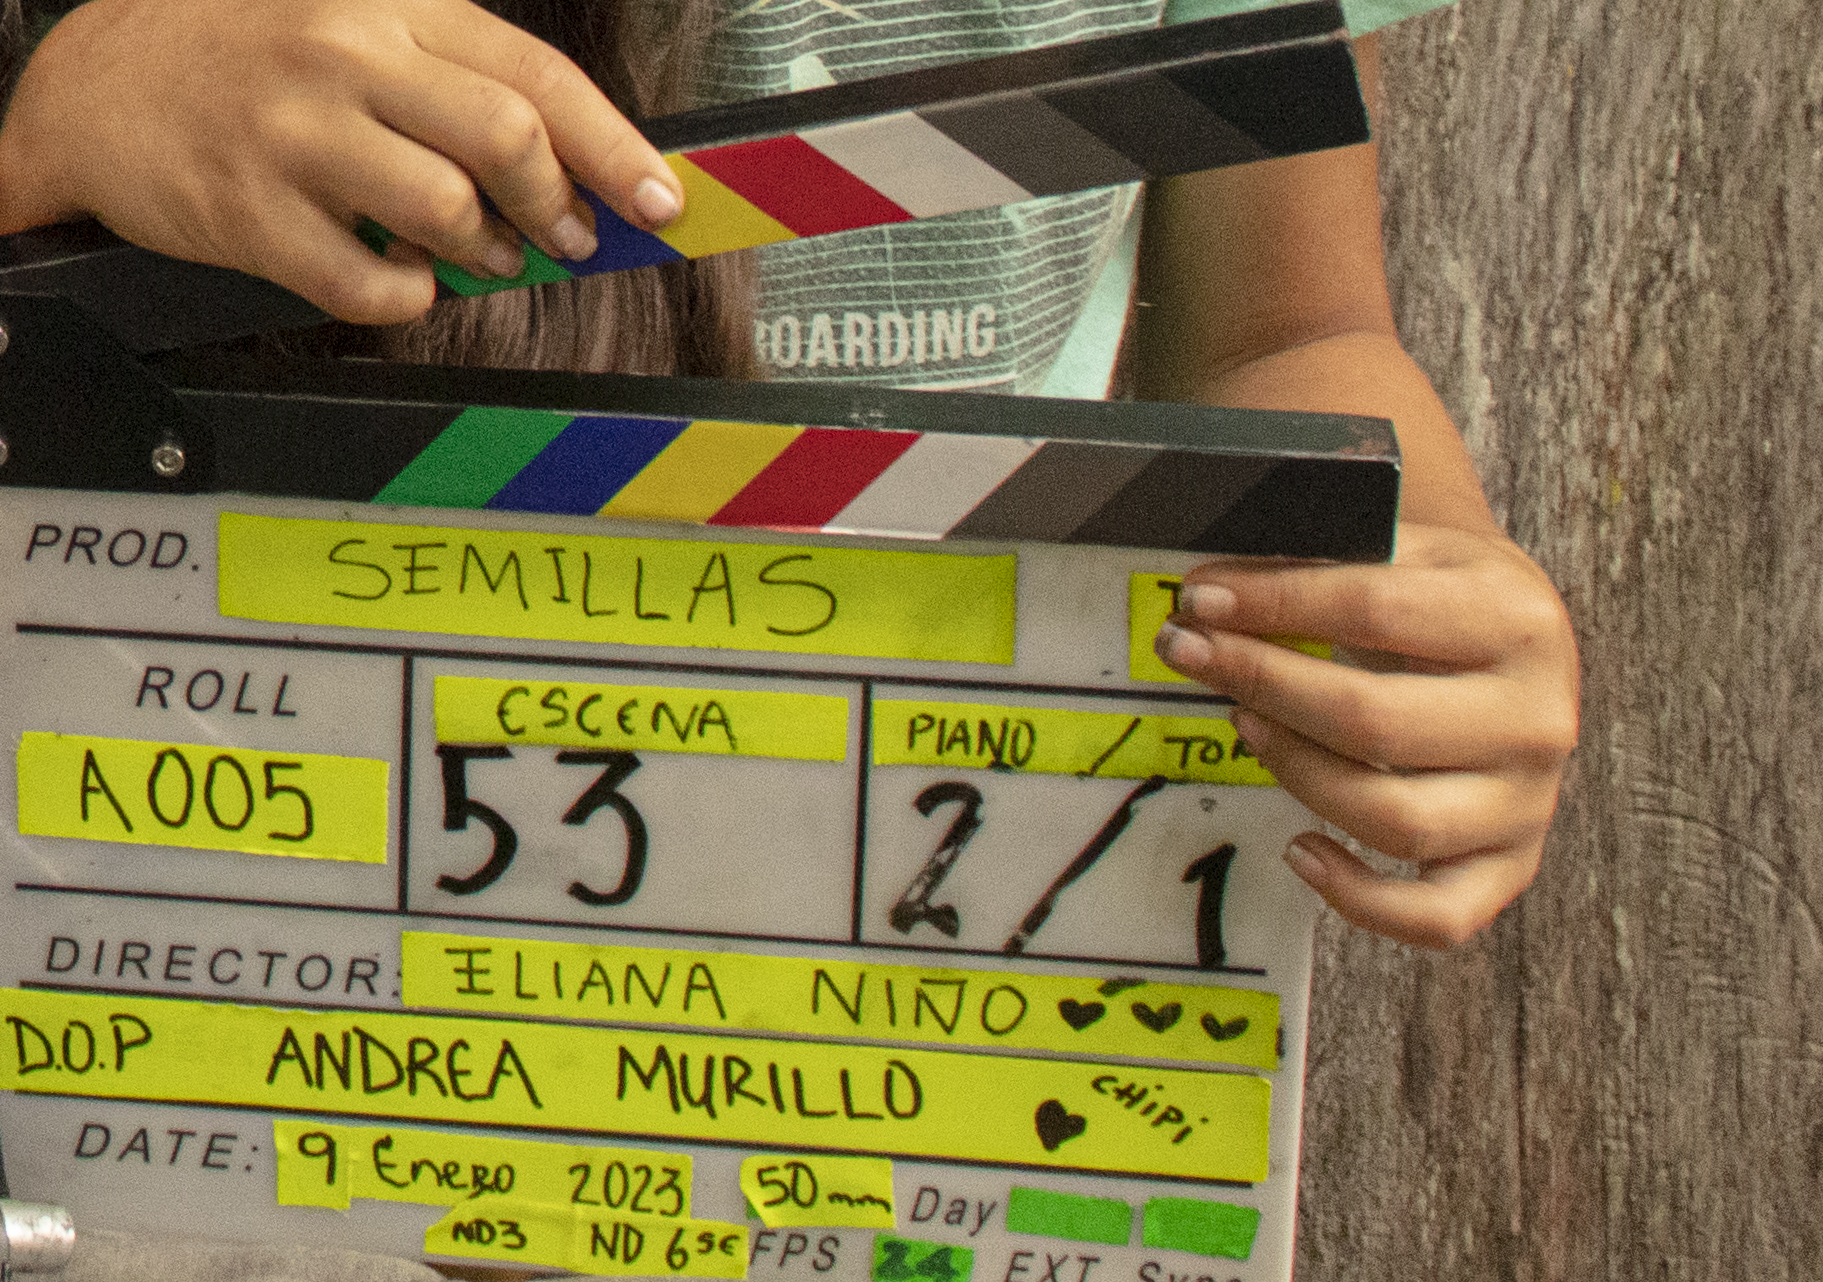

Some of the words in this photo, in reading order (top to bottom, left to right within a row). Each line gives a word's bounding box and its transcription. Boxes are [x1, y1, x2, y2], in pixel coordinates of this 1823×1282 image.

[24, 524, 200, 572] PROD.
[328, 539, 838, 636] SEMILLAS
[135, 666, 298, 717] ROLL
[496, 686, 738, 749] ESCENA
[79, 748, 315, 843] A005
[435, 743, 650, 905] 53
[46, 935, 401, 997] DIRECTOR:
[444, 947, 728, 1019] ELIANA
[811, 968, 1028, 1036] NIÑO
[5, 1013, 152, 1073] D.O.P
[264, 1025, 545, 1109] ANDREA
[616, 1043, 924, 1121] MURILLO
[74, 1122, 260, 1172] DATE:
[297, 1130, 337, 1186] 9
[568, 1160, 685, 1218] 2023
[589, 1220, 645, 1265] ND
[909, 1186, 998, 1237] Day
[749, 1231, 841, 1272] FPS
[1003, 1251, 1101, 1281] EXT
